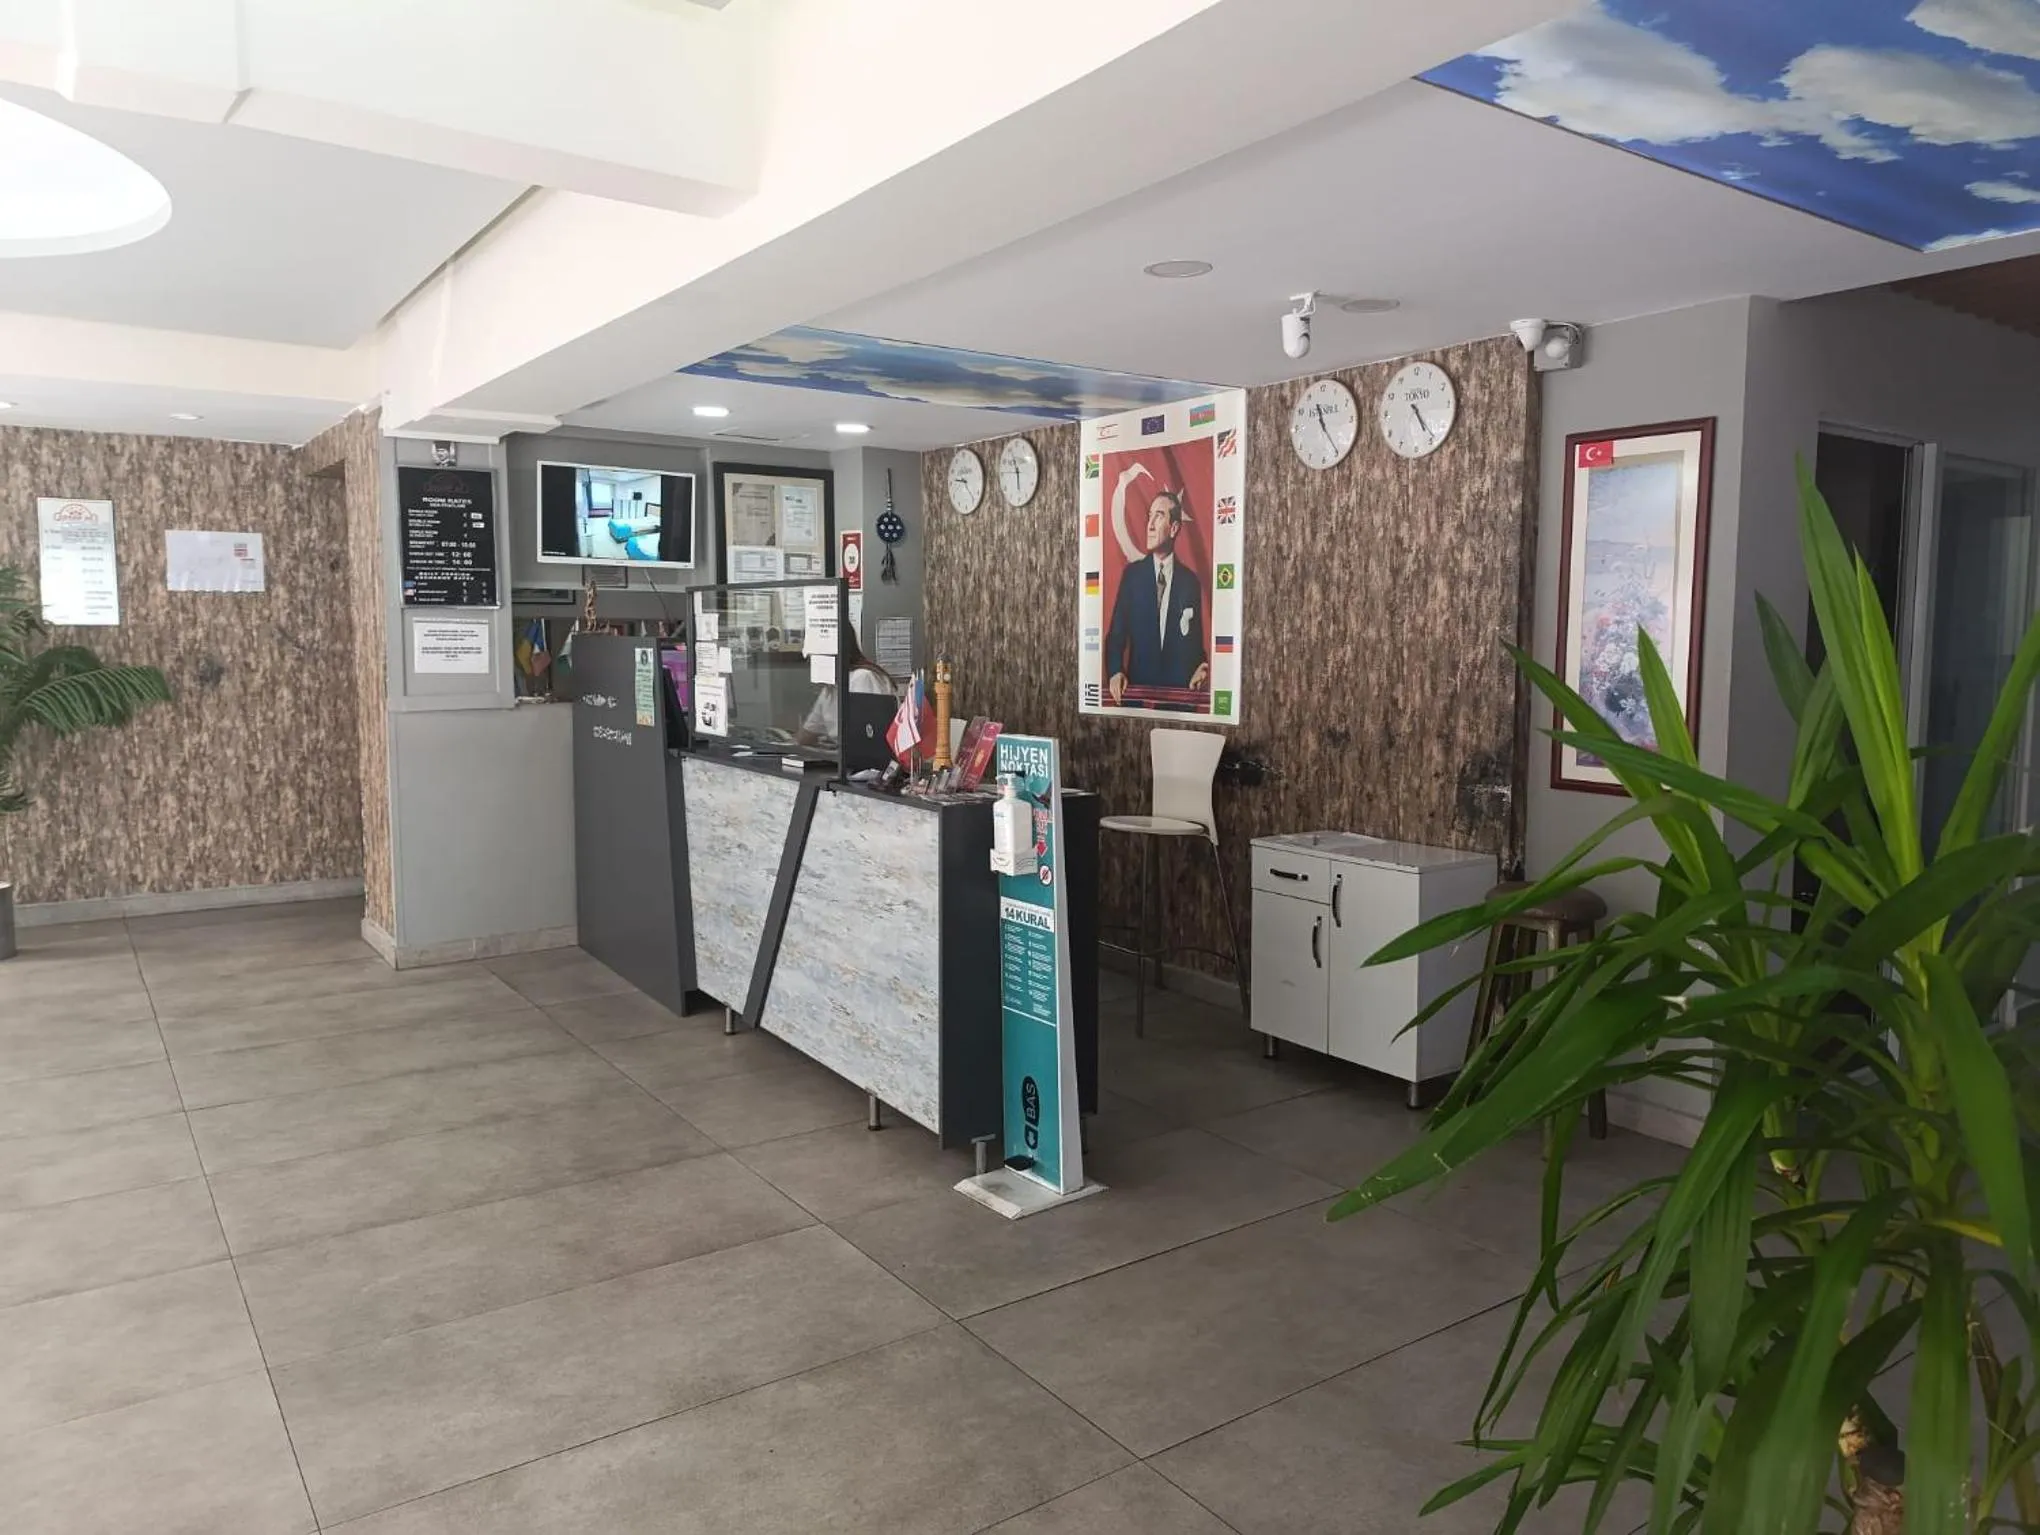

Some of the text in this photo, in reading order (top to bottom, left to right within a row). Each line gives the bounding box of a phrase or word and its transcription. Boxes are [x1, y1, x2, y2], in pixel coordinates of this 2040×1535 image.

[1405, 388, 1430, 401] TOKYO
[1015, 909, 1051, 929] KURAL
[1026, 1083, 1036, 1119] BAS
